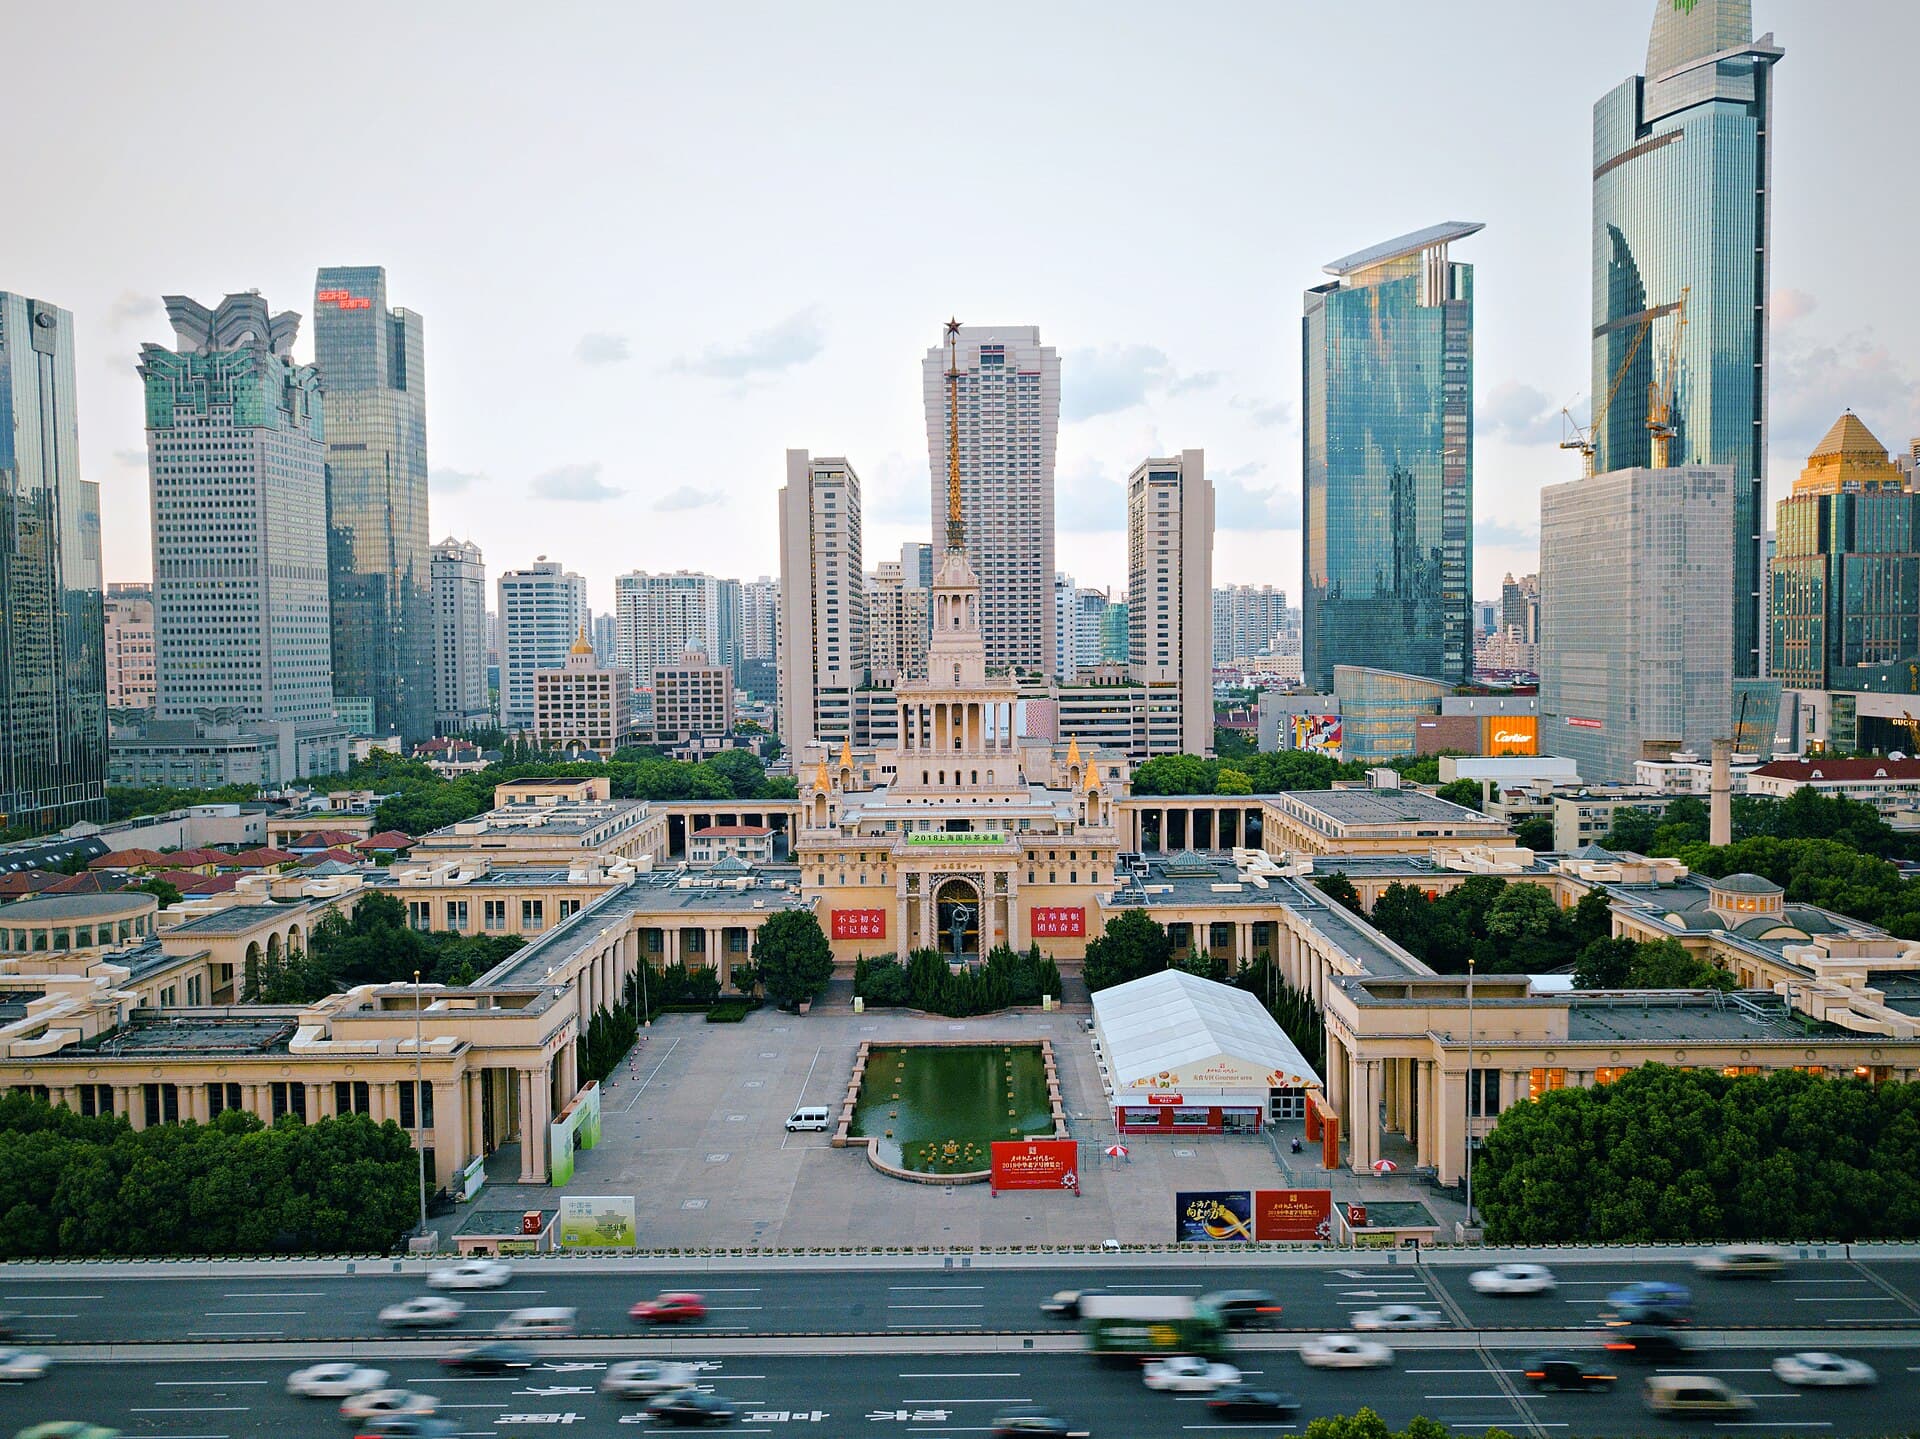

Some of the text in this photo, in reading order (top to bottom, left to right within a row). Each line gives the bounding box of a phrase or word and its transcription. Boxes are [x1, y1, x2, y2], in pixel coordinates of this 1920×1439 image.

[319, 291, 349, 301] SOHO
[1494, 730, 1533, 743] Cartier
[914, 834, 999, 842] 2018上海国际茶业展
[838, 914, 880, 924] 不忘初心
[1037, 912, 1080, 921] 高举旗帜
[837, 925, 880, 935] 牢记使命
[1037, 923, 1080, 932] 团结奋进
